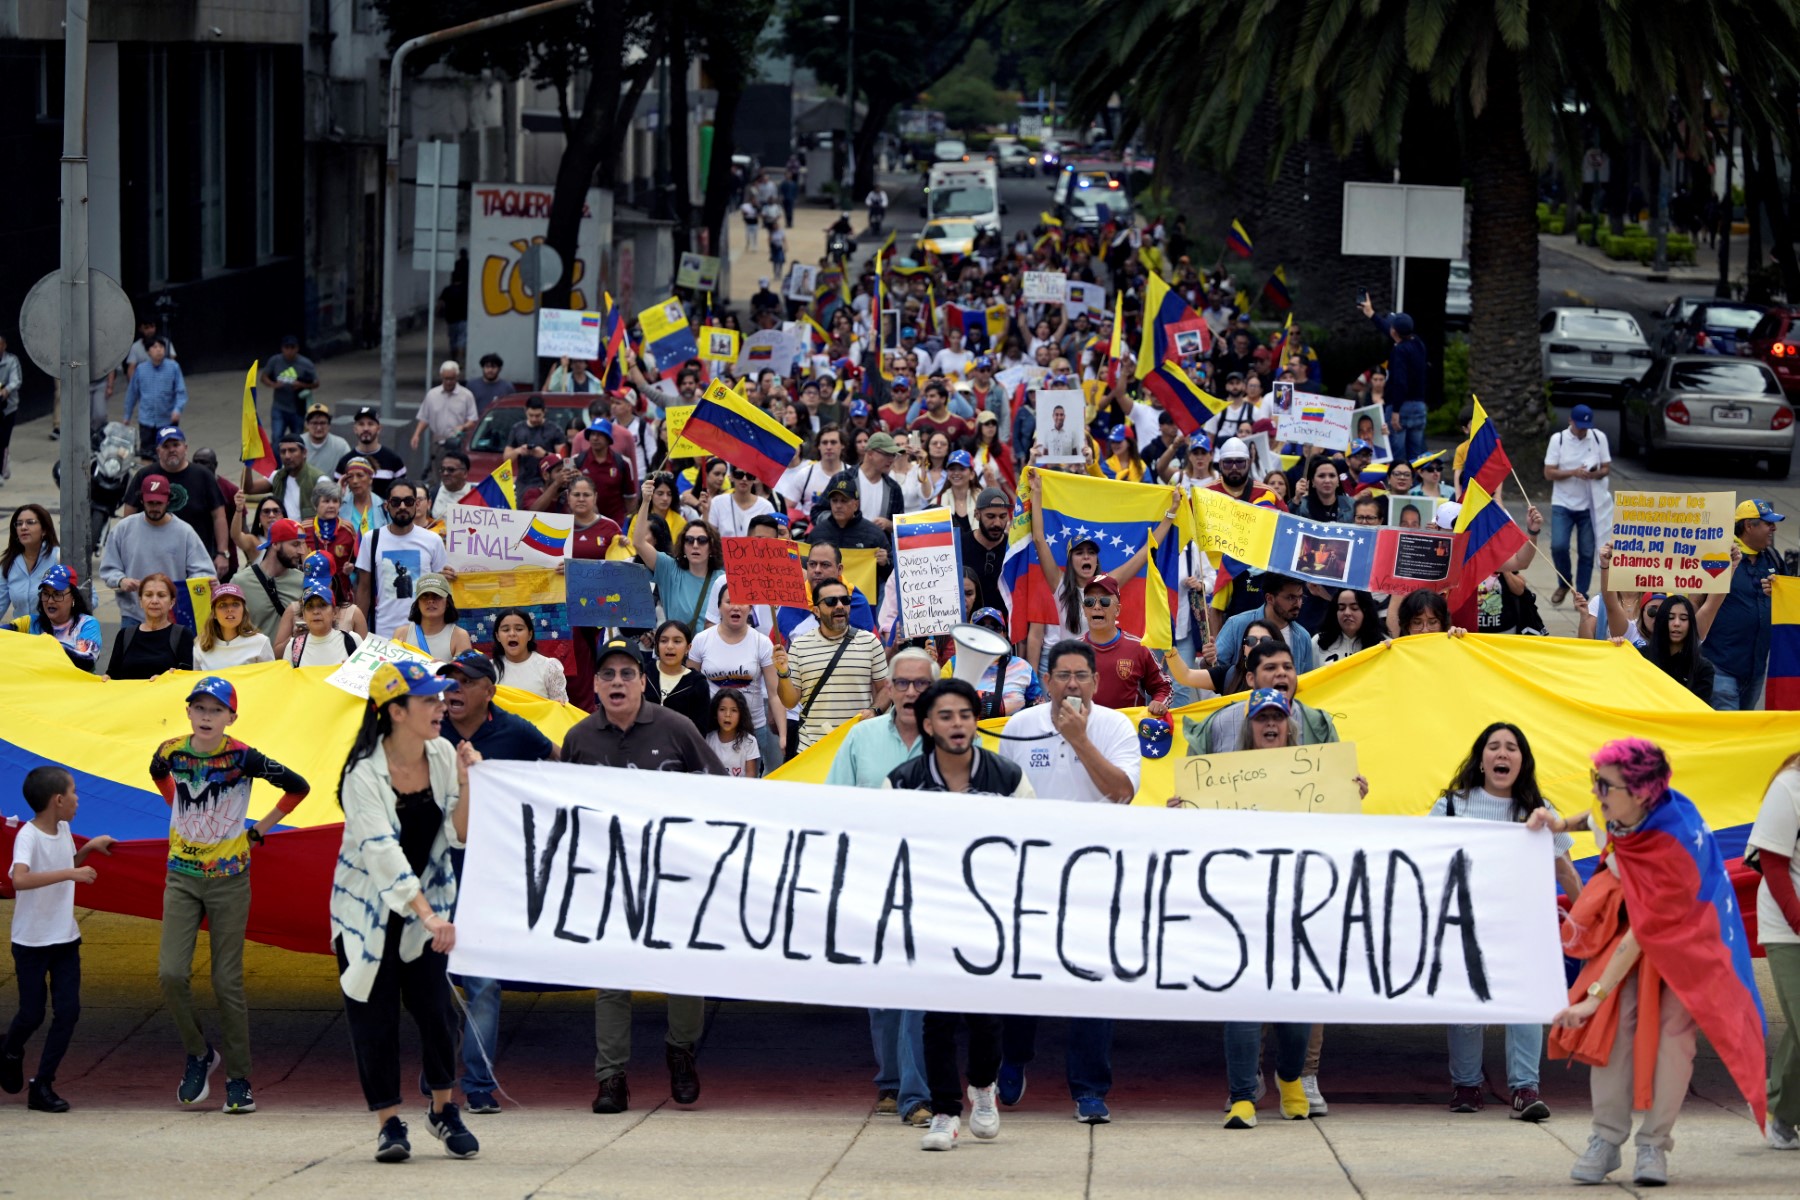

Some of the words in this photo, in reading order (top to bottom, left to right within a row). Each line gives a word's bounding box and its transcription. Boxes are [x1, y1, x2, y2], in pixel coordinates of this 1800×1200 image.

[1615, 493, 1655, 507] Lucha
[1658, 495, 1682, 509] por
[1686, 494, 1706, 509] los
[452, 508, 499, 529] HASTA
[501, 513, 514, 523] EL
[1613, 523, 1661, 538] aunque
[1663, 526, 1679, 538] no
[1681, 526, 1694, 539] te
[1694, 526, 1724, 540] falte
[726, 539, 749, 559] Por
[1613, 538, 1646, 554] nada,
[1648, 540, 1665, 554] pq
[1673, 541, 1697, 556] hay
[899, 555, 929, 567] Quiero
[933, 553, 951, 563] ver
[1612, 553, 1660, 569] chamos
[1664, 556, 1674, 571] q
[1680, 556, 1700, 570] les
[900, 569, 908, 578] a
[910, 565, 928, 576] mis
[930, 562, 954, 576] hijos
[1635, 574, 1664, 588] falta
[1674, 575, 1703, 589] todo
[911, 595, 926, 605] NO
[906, 618, 958, 636] Liberta
[1031, 753, 1049, 761] CON
[521, 802, 917, 966] VENEZUELA
[952, 835, 1493, 1002] SECUESTRADA
